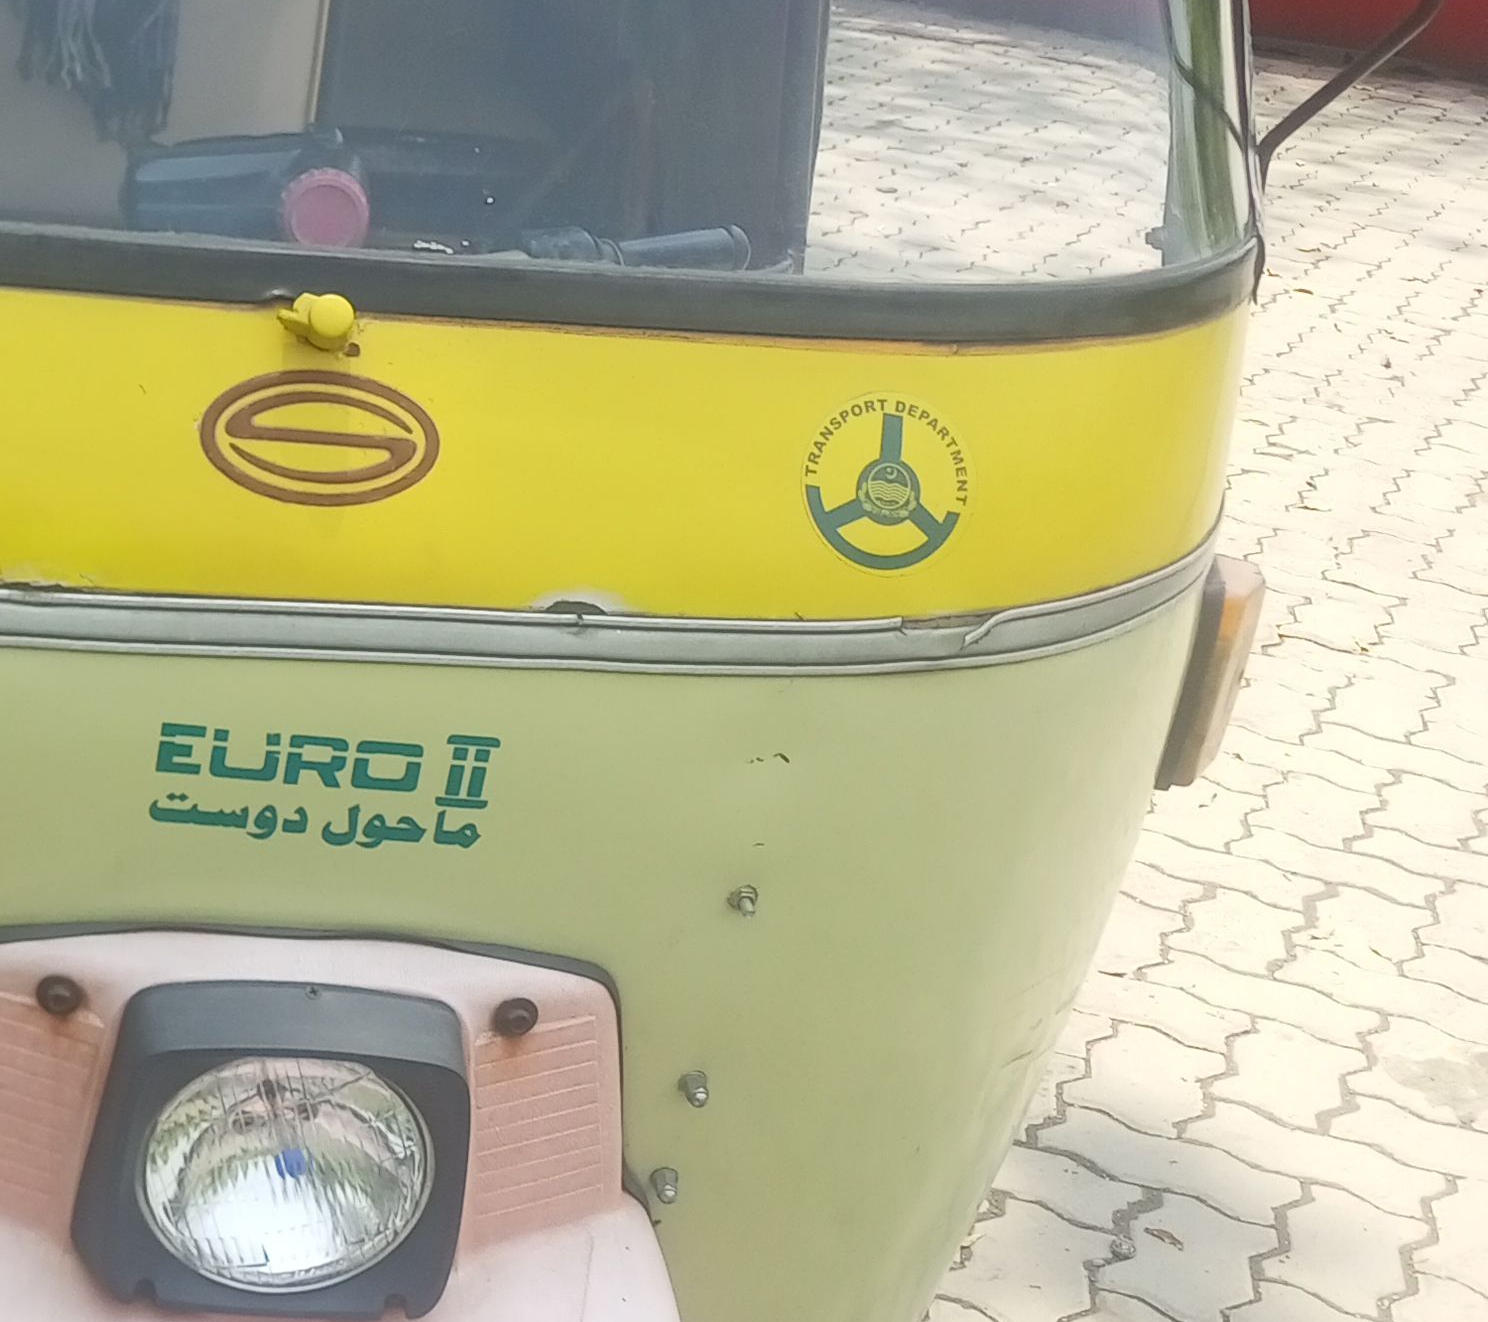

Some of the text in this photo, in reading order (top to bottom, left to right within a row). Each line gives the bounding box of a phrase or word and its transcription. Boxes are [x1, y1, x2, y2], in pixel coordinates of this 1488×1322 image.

[805, 398, 968, 507] TRANSPORT DEPARTMENT
[155, 722, 501, 810] EURO II
[149, 792, 482, 849] ماحول دوست
